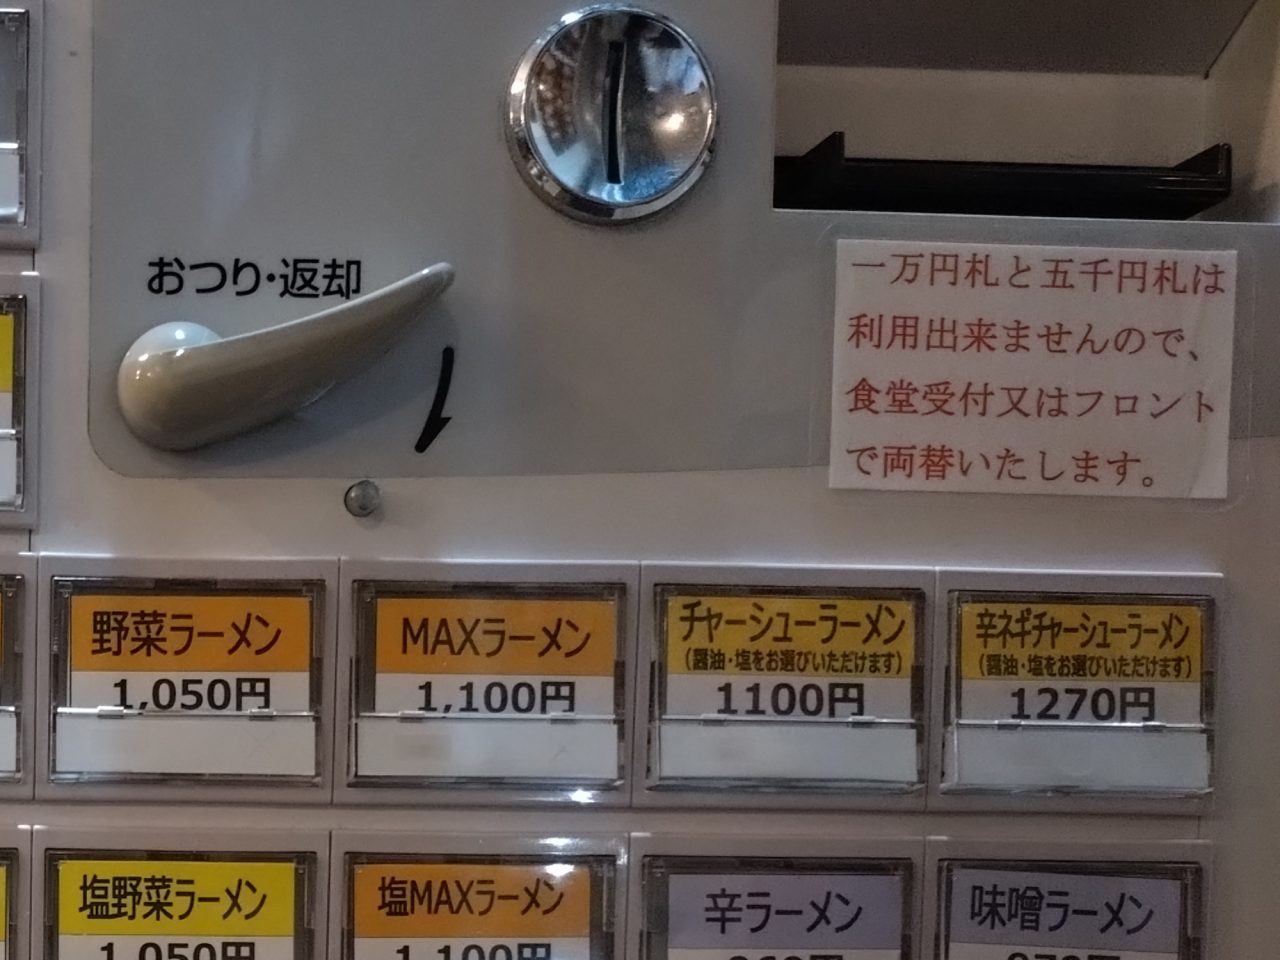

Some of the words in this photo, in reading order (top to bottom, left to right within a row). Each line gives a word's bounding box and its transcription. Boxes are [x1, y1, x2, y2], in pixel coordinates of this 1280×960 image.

[146, 256, 361, 299] おつり・返却
[851, 251, 1226, 295] 一万円札と五千円札は
[847, 313, 1199, 362] 利用出来ませんので、
[845, 377, 1215, 423] 食堂受付又はフロント
[846, 444, 1154, 488] で両替いたします。
[91, 610, 282, 657] 野菜ラーメン
[401, 617, 591, 658] MAXラーメン
[679, 600, 905, 645] チャーシューラーメン
[975, 608, 1190, 650] 辛ネギチャーシューラーメン
[113, 678, 271, 715] 1,050円
[417, 680, 576, 718] 1,100円
[717, 682, 865, 718] 1100円
[1010, 687, 1156, 722] 1270円
[79, 874, 267, 921] 塩野菜ラーメン
[377, 876, 565, 917] 塩MAXラーメン
[705, 888, 863, 935] 辛ラーメン
[970, 884, 1154, 935] 味噌ラーメン
